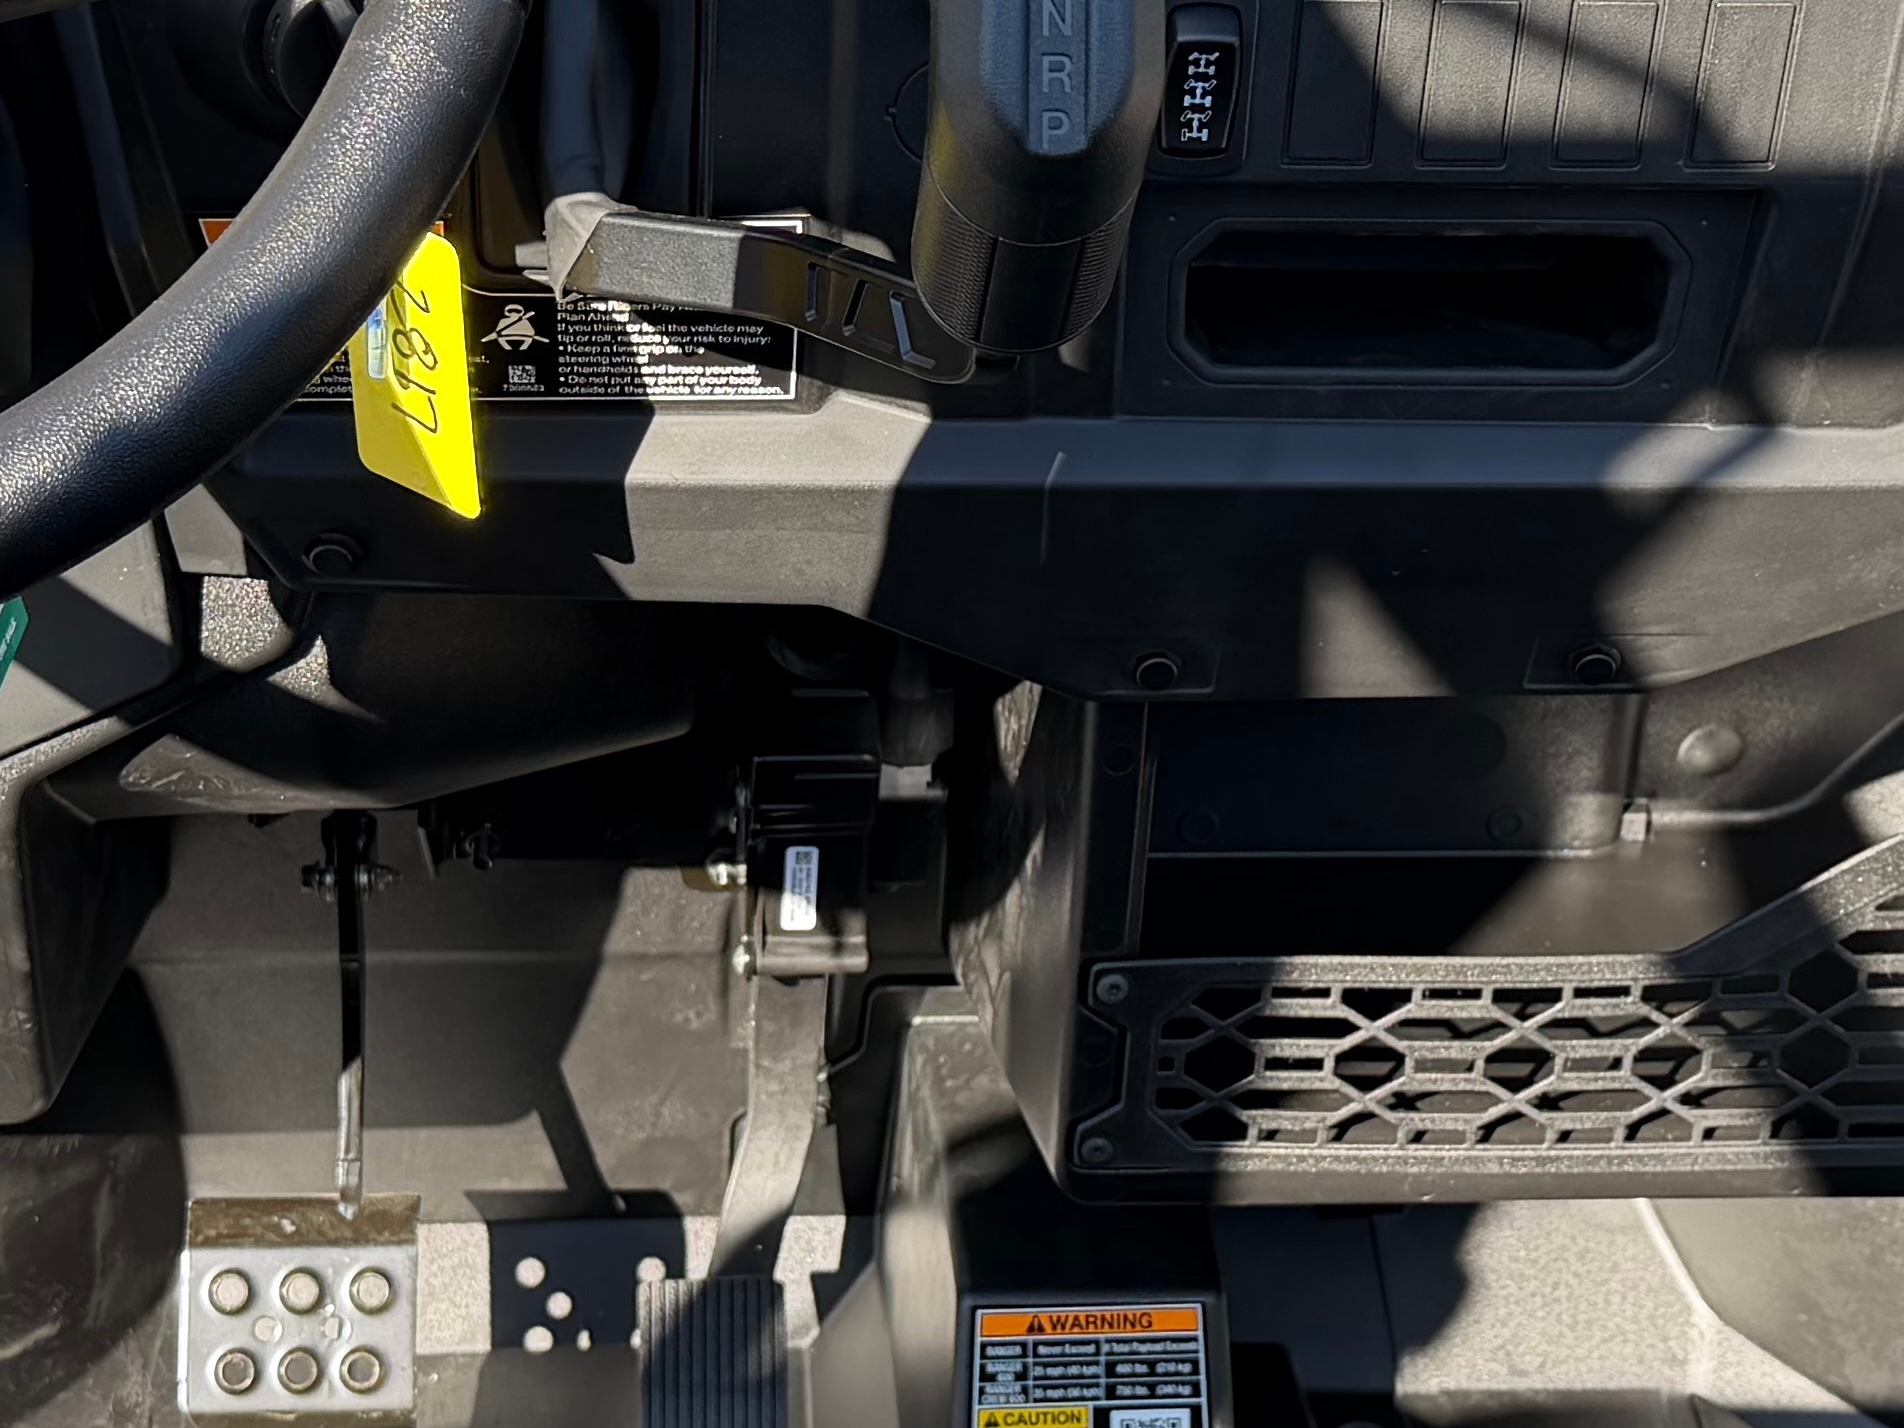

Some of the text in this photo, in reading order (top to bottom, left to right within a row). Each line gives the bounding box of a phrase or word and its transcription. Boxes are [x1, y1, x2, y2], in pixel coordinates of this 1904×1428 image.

[1041, 53, 1072, 93] R
[1042, 109, 1071, 149] P
[557, 302, 574, 310] Be
[577, 301, 606, 311] Sure
[652, 303, 674, 312] Pay
[557, 312, 629, 321] Plan Ahead
[568, 324, 590, 332] you
[593, 323, 624, 331] think
[626, 324, 640, 332] or
[641, 322, 665, 332] feel
[690, 324, 734, 332] vehicle
[737, 326, 763, 334] may
[557, 334, 573, 343] tip
[592, 334, 614, 342] roll,
[617, 333, 661, 342] reduce
[662, 335, 690, 344] your
[693, 334, 715, 342] risk
[733, 335, 770, 344] injury:
[567, 344, 600, 353] Keep
[613, 344, 637, 352] firm
[638, 344, 664, 354] grip
[665, 344, 682, 353] on
[684, 344, 704, 353] the
[558, 354, 648, 364] steering wheel
[640, 364, 666, 374] and
[667, 364, 703, 374] brace
[705, 364, 759, 375] yourself.
[568, 374, 761, 386] Do not put any part of your body
[558, 385, 604, 393] outside
[646, 385, 690, 393] vehicle
[713, 386, 737, 395] any
[738, 386, 783, 394] reason.
[1048, 1312, 1153, 1332] WARNING
[1002, 1410, 1082, 1426] CAUTION
